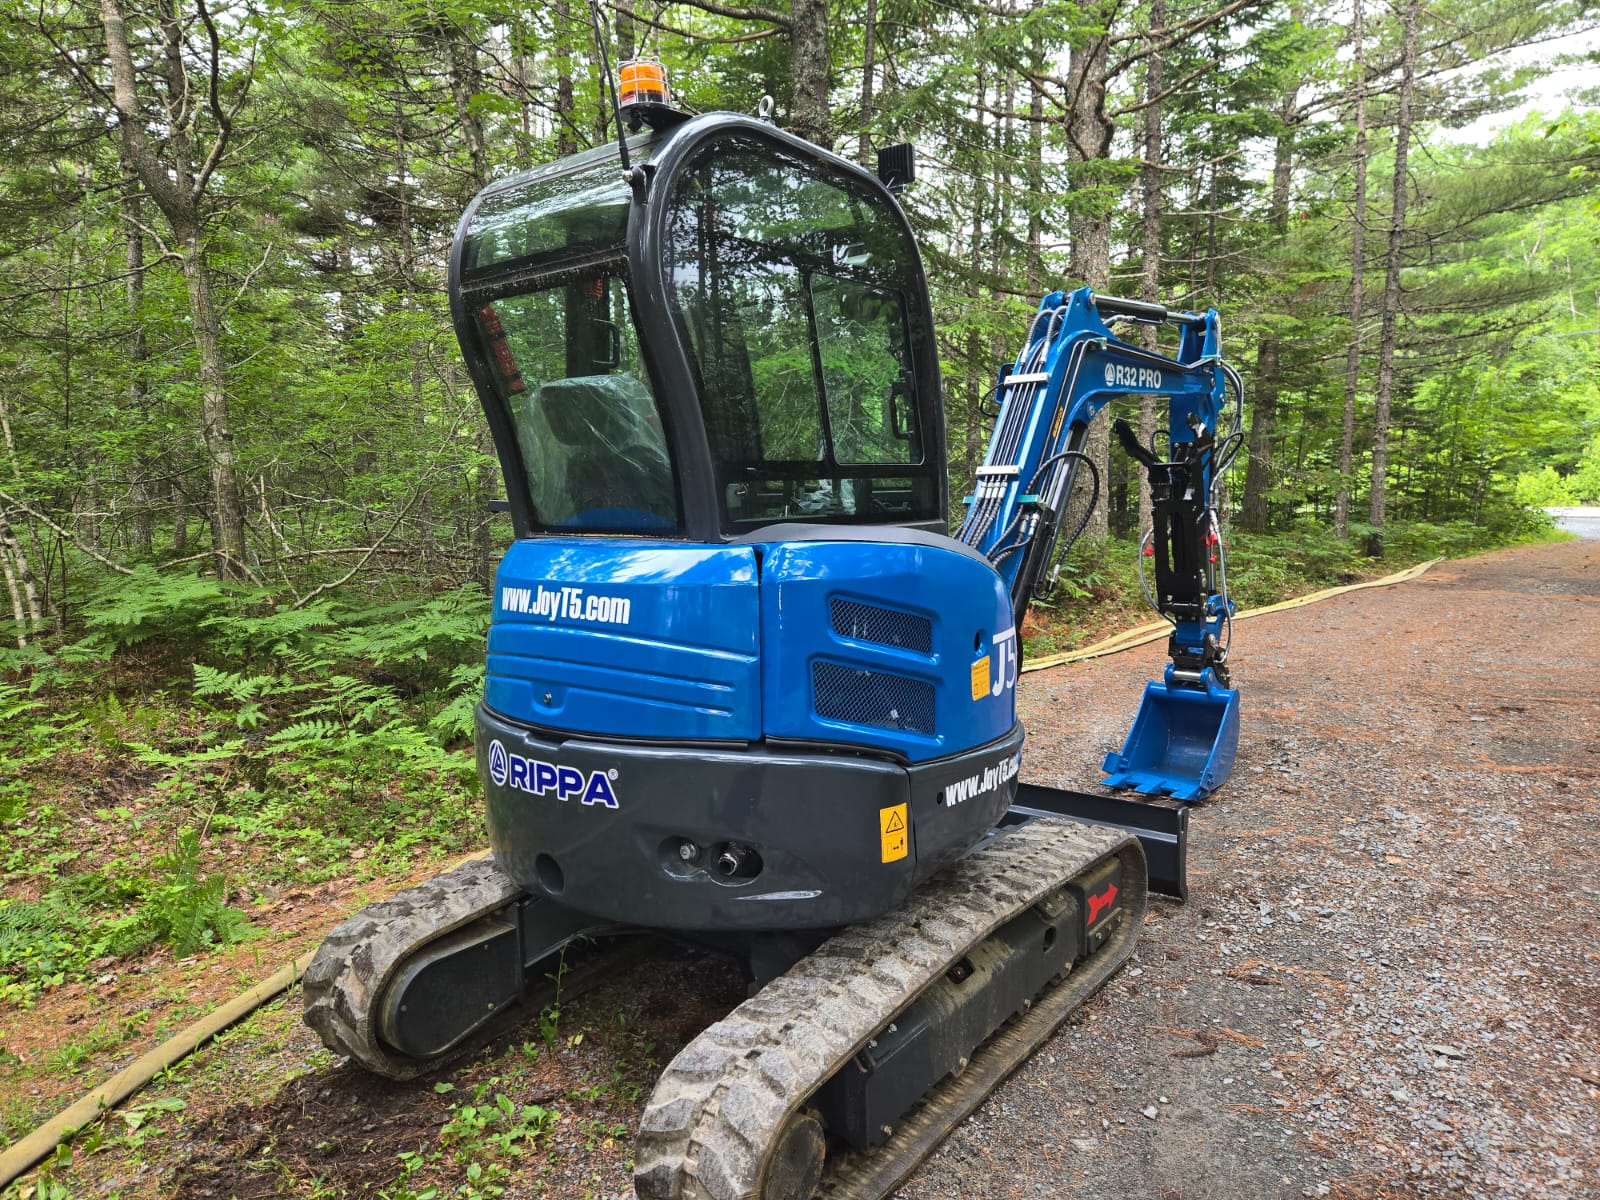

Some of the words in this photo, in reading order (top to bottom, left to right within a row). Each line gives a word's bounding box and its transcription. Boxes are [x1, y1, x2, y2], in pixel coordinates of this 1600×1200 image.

[1116, 365, 1137, 387] R32
[1139, 368, 1162, 389] PRO
[502, 585, 631, 624] www.JoyT5.com
